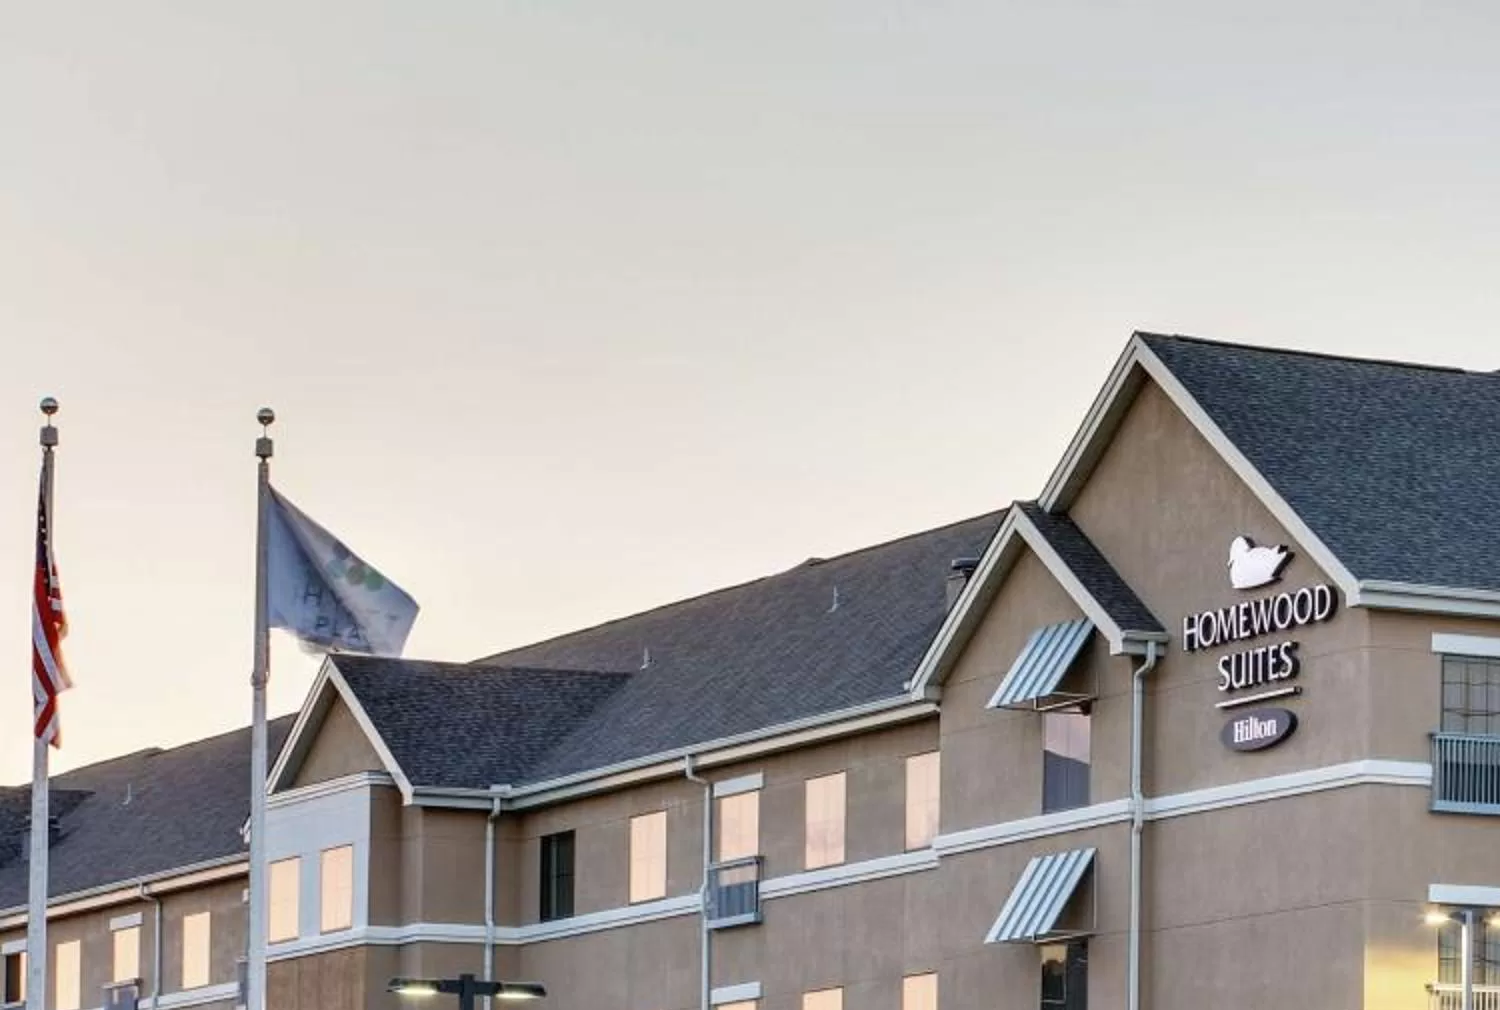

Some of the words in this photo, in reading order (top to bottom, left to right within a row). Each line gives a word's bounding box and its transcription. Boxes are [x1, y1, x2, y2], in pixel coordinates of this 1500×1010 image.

[1183, 584, 1332, 651] HOMEWOOD
[1217, 641, 1294, 691] SUITES
[1233, 715, 1277, 743] Hilton
